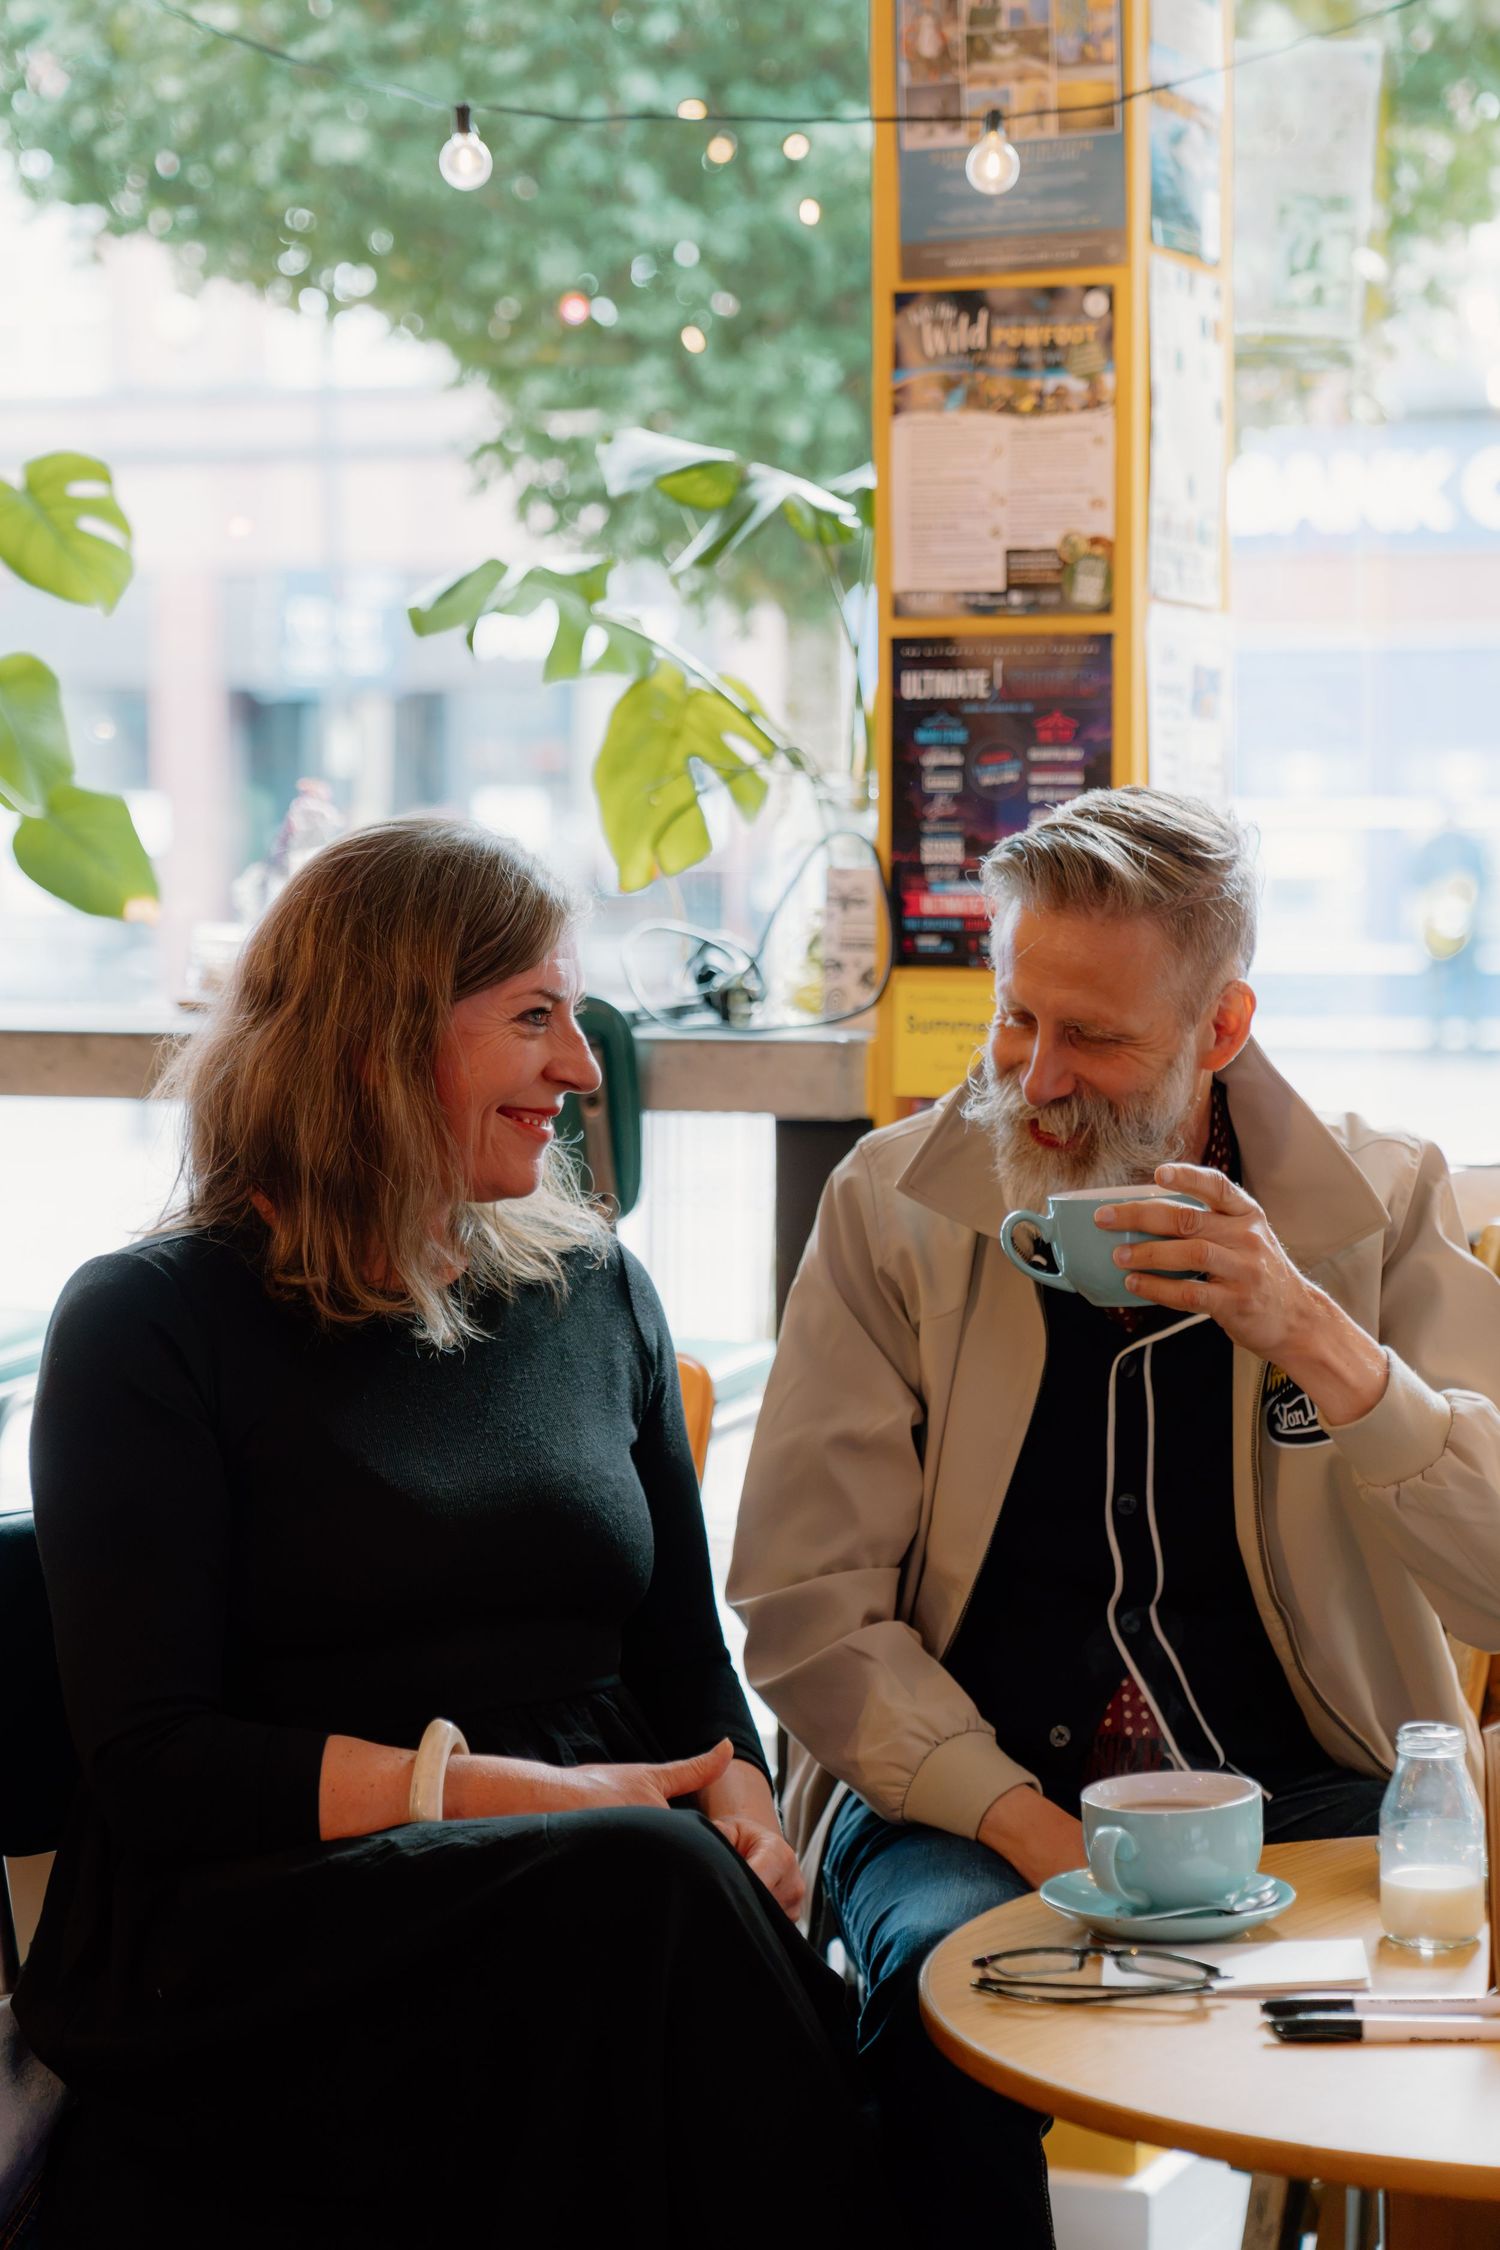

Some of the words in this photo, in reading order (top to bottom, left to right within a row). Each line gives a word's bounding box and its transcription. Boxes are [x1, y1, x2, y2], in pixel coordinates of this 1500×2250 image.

[920, 307, 989, 359] Wild
[900, 668, 991, 700] ULTIMATE
[906, 1014, 988, 1034] Summe
